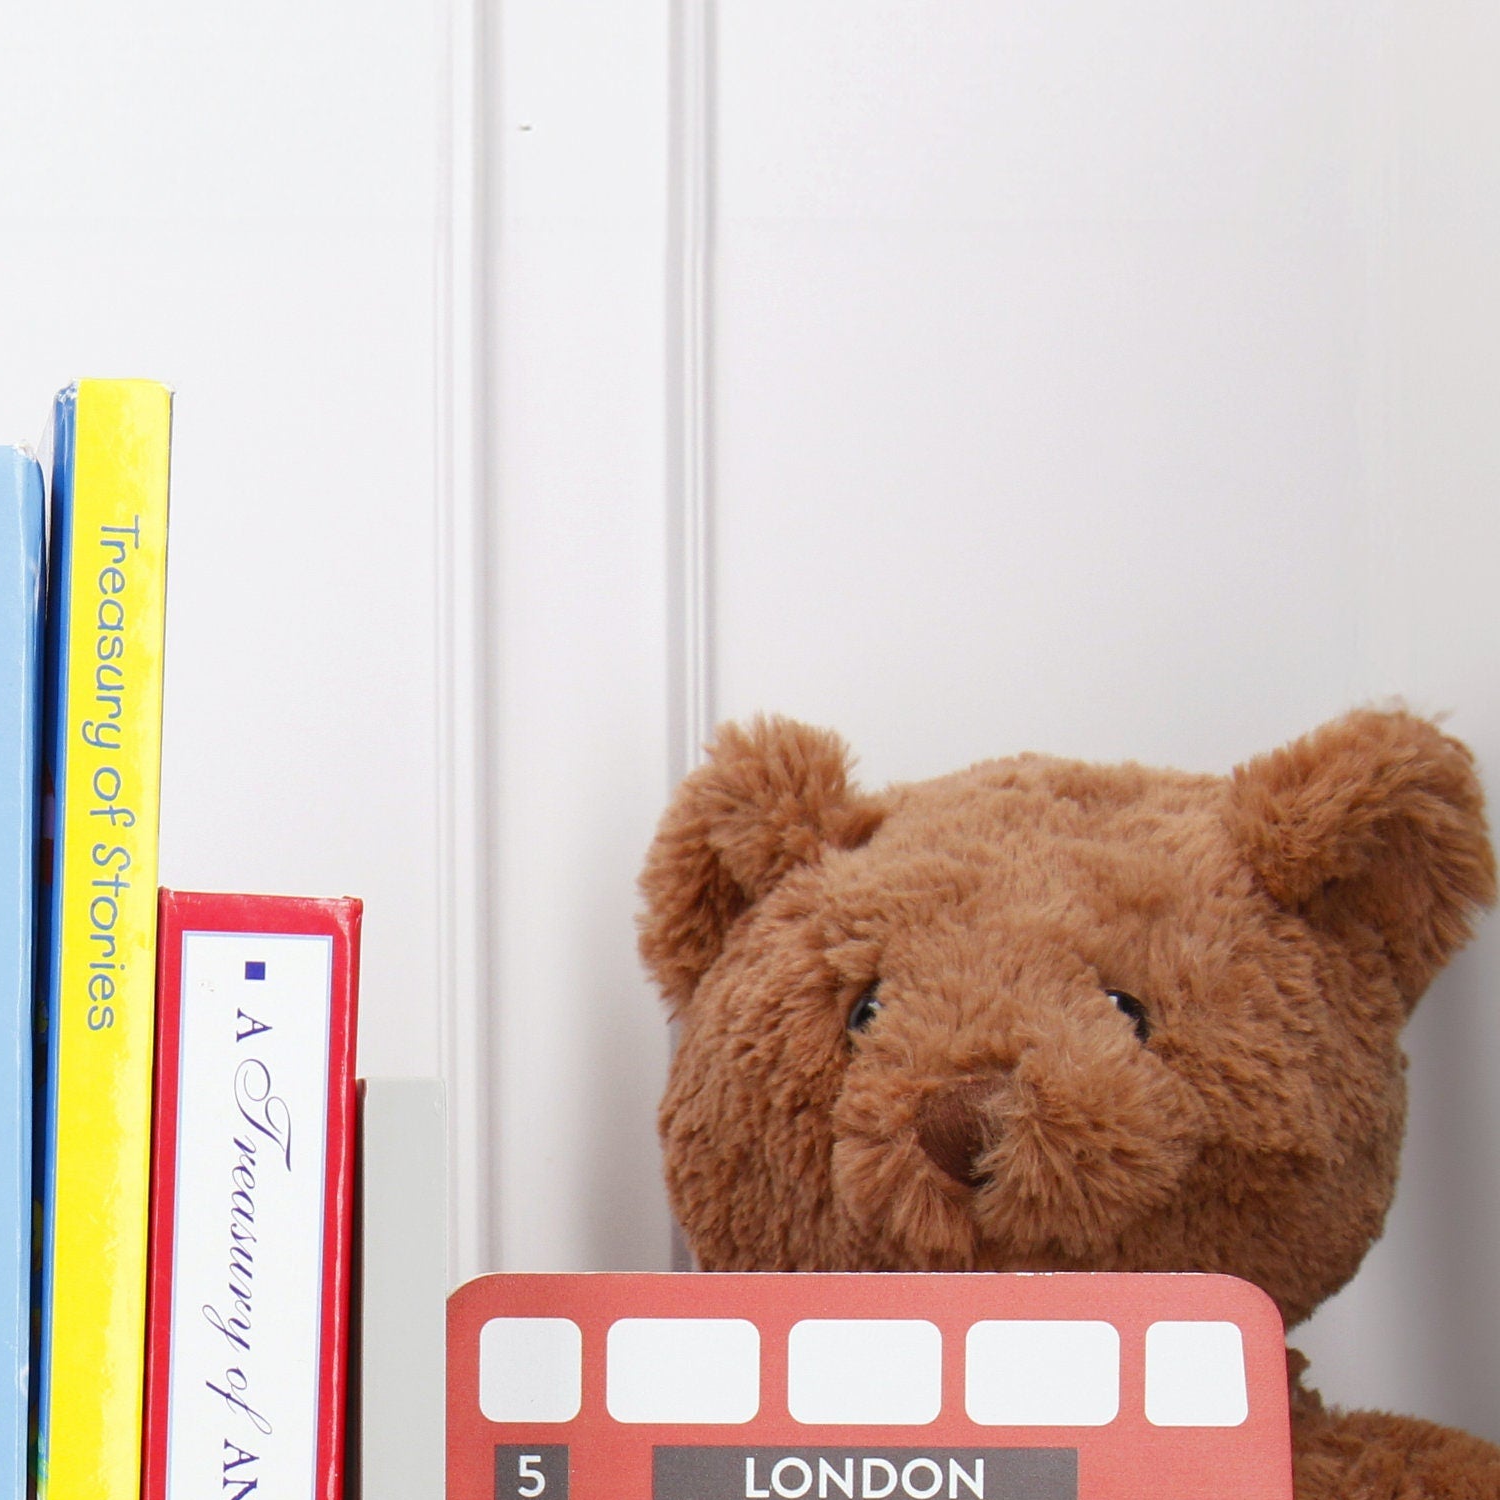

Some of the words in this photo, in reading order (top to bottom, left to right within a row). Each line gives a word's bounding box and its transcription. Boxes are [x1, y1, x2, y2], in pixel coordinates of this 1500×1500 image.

[82, 514, 141, 750] Treasury
[90, 766, 136, 828] of
[88, 843, 132, 1032] Stories
[235, 1007, 273, 1043] A
[203, 1058, 292, 1351] Treasury
[205, 1366, 272, 1435] of
[518, 1455, 546, 1498] 5
[746, 1456, 985, 1500] LONDON
